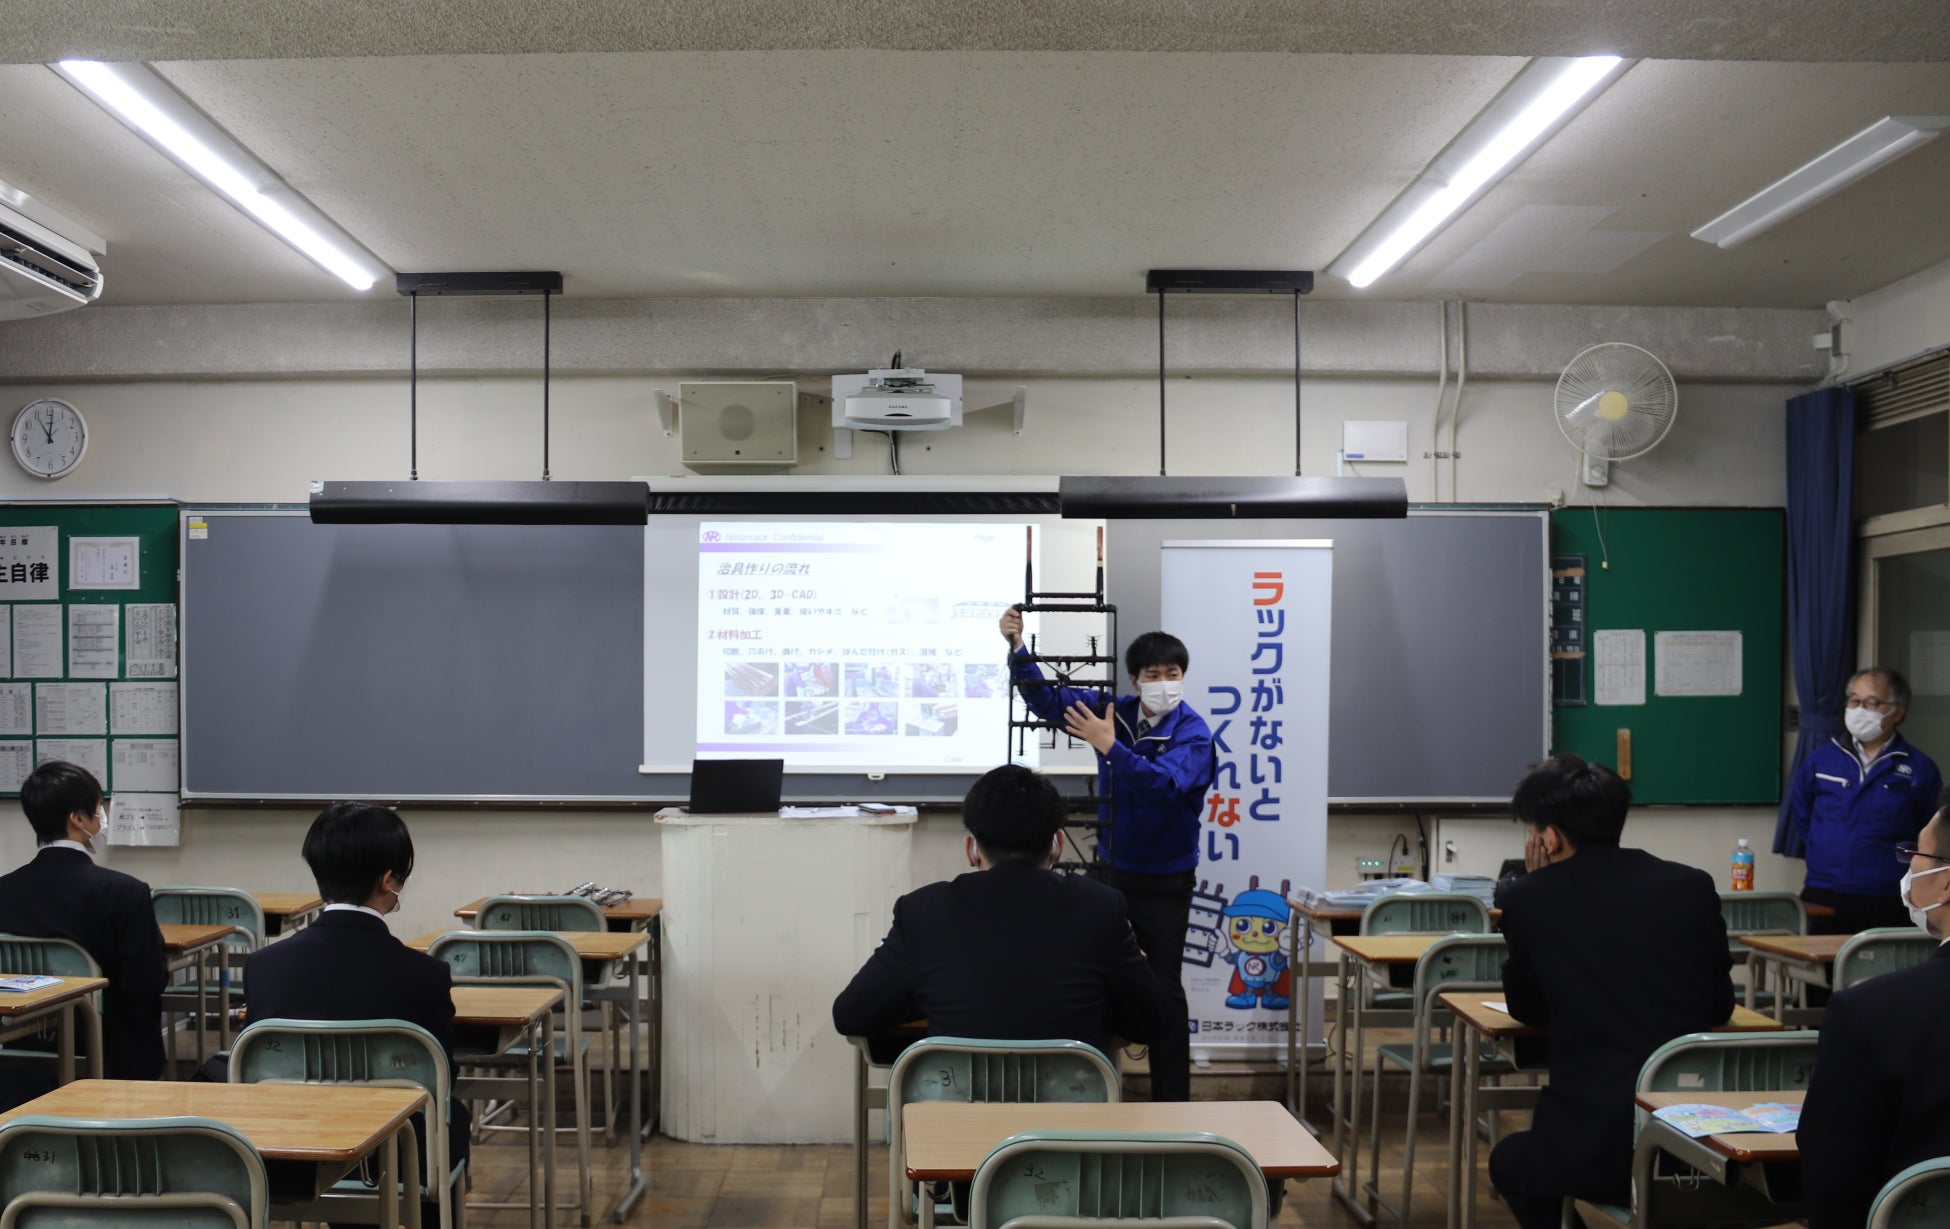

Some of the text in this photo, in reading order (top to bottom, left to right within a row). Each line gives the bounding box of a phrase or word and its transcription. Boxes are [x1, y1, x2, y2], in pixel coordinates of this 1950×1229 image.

[25, 420, 32, 431] 10
[772, 532, 824, 541] Confidential
[717, 562, 811, 575] 治具作りの流れ
[1249, 571, 1285, 821] ラックがないと
[1206, 686, 1242, 861] つくれない
